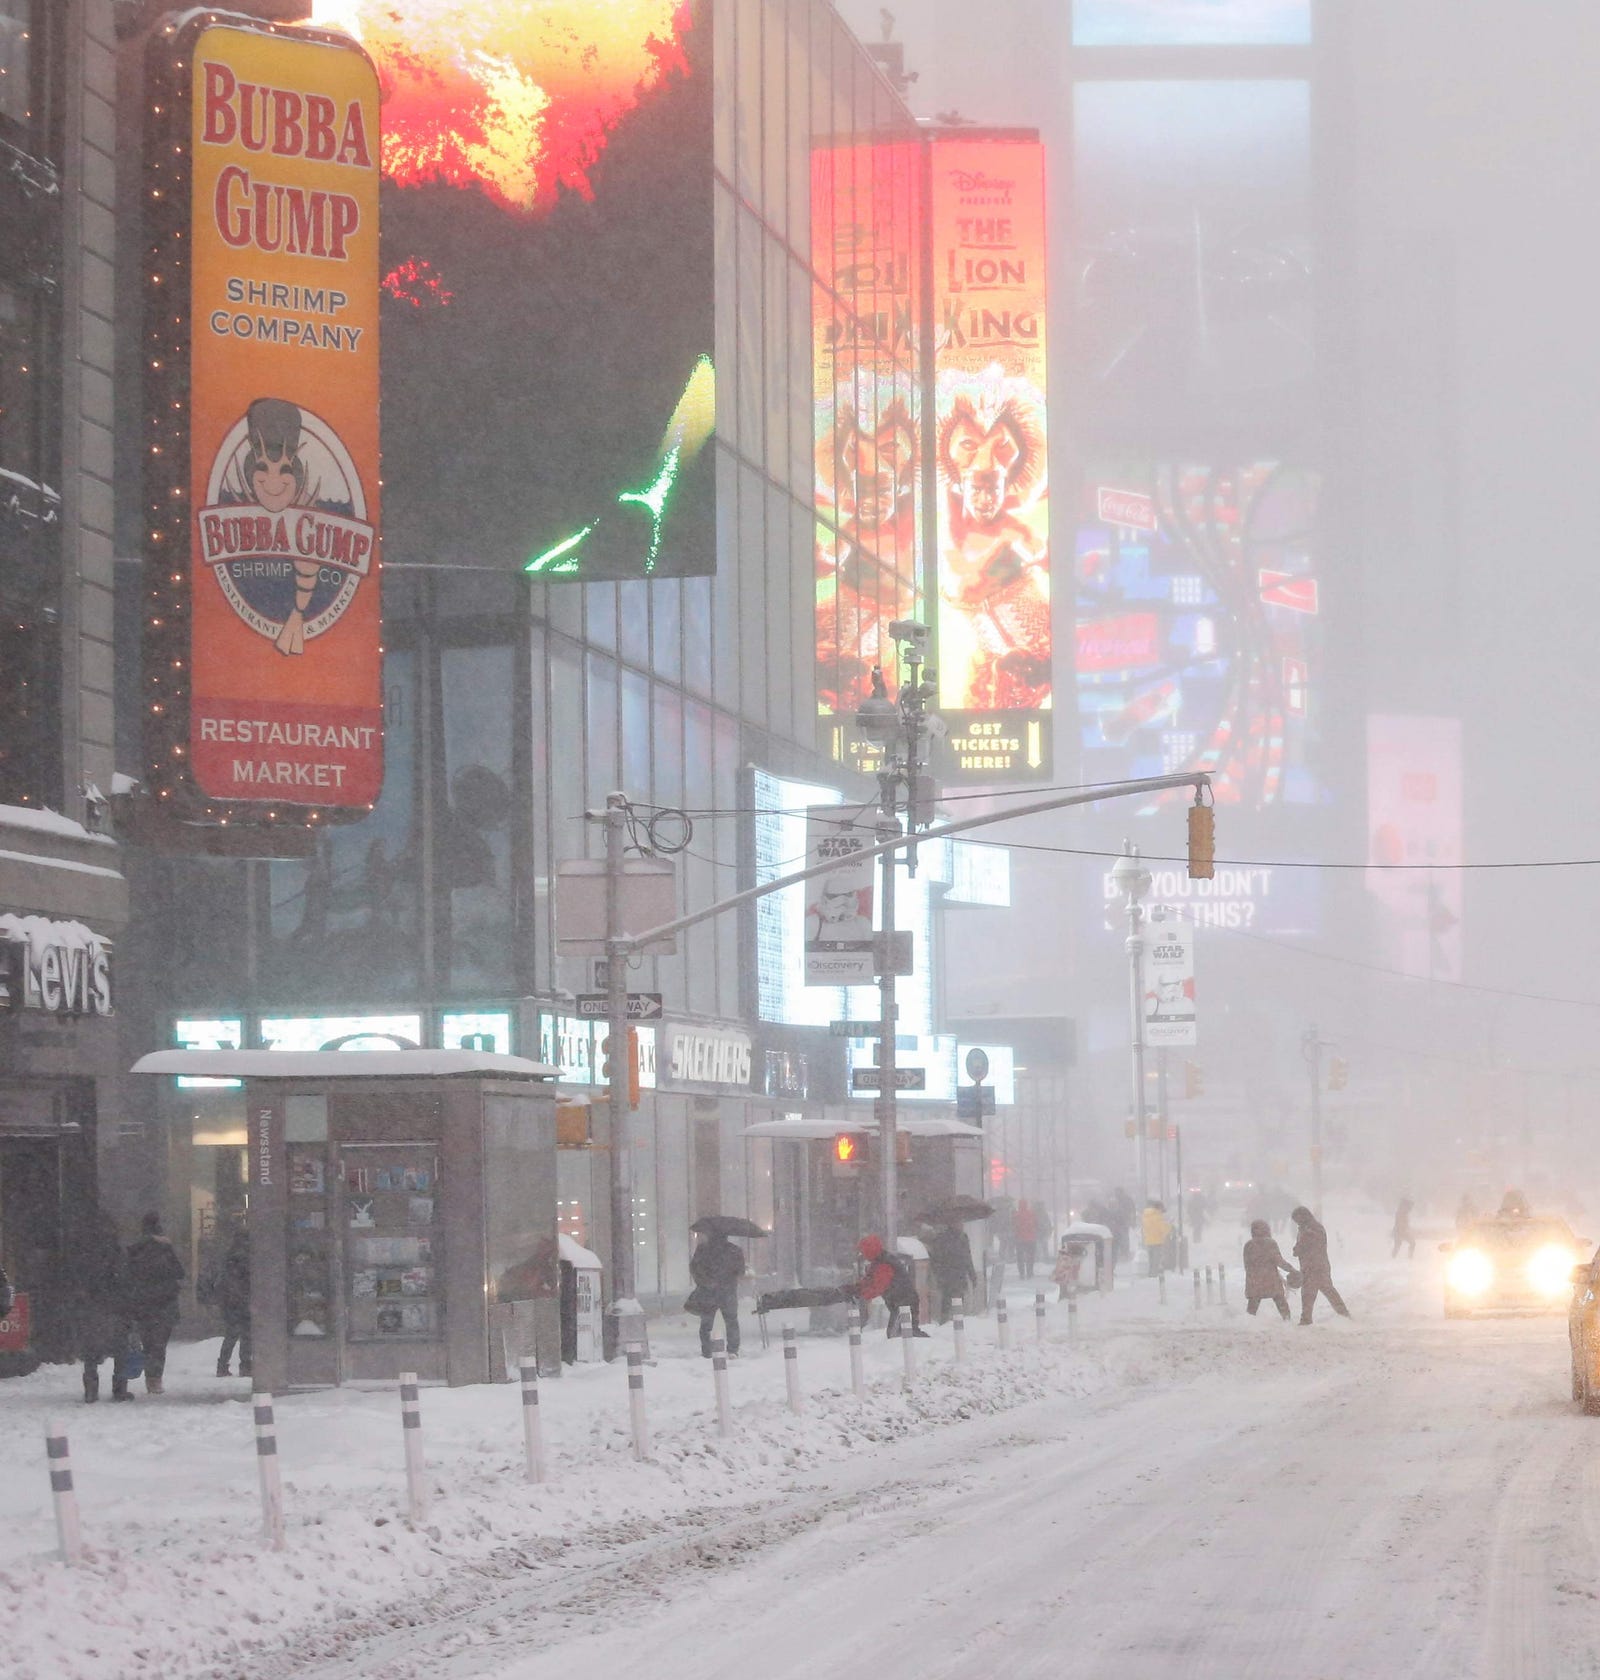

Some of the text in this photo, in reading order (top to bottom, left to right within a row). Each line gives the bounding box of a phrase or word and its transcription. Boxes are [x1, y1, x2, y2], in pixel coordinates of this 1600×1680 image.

[202, 61, 372, 169] BUBBA
[950, 169, 1016, 198] Disney
[215, 165, 360, 260] GUMP
[956, 218, 1012, 243] THE
[947, 250, 1025, 293] LION
[227, 278, 347, 315] SHRIMP
[210, 311, 362, 351] COMPANY
[943, 299, 1039, 349] KING
[204, 512, 370, 568] BUBBA GUMP
[232, 563, 342, 585] SHRIMP CO
[216, 565, 357, 635] RESTAURANT & MARKET
[200, 718, 377, 750] RESTAURANT
[969, 723, 1002, 736] GET
[951, 738, 1020, 752] TICKETS
[232, 759, 347, 788] MARKET
[960, 756, 1011, 769] HERE!
[816, 838, 863, 849] STAR
[1149, 871, 1191, 897] YOU
[1195, 869, 1273, 897] DIDN'T
[1193, 901, 1256, 928] THIS?
[1153, 945, 1185, 953] STAR
[810, 960, 864, 971] Discovery
[583, 1001, 609, 1012] ONE
[671, 1035, 751, 1084] SKECHERS
[260, 1109, 273, 1185] Newsstand
